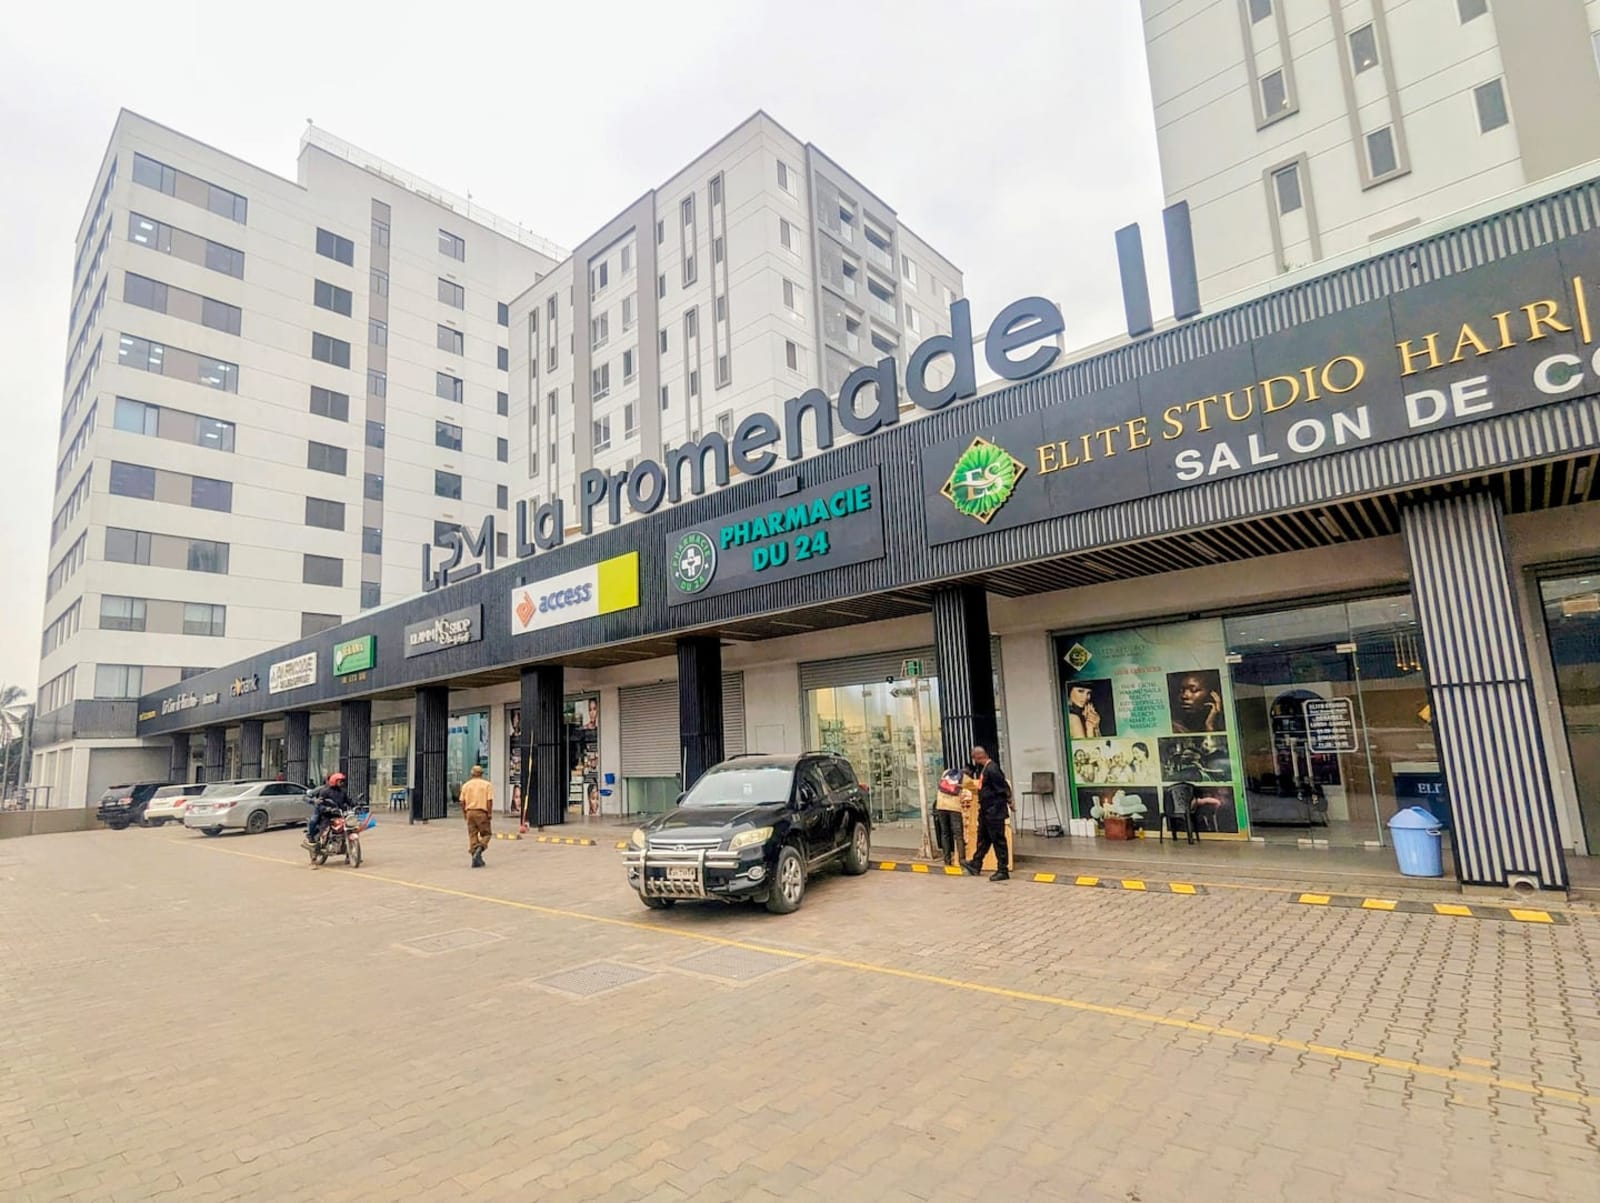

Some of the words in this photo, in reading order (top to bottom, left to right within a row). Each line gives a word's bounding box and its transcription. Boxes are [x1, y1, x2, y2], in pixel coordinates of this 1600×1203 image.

[1036, 415, 1153, 476] ELITE
[1162, 354, 1366, 441] STUDIO
[1397, 299, 1573, 377] HAIR
[1175, 405, 1372, 482] SALON
[1404, 375, 1494, 429] DE
[1533, 346, 1600, 395] C
[516, 499, 564, 559] La
[580, 296, 1065, 535] Promenade
[719, 483, 872, 550] PHARMACIE
[671, 534, 711, 568] PHARMACIE
[752, 540, 788, 572] DU
[793, 530, 829, 562] 24
[538, 582, 593, 614] access
[679, 581, 692, 591] DU
